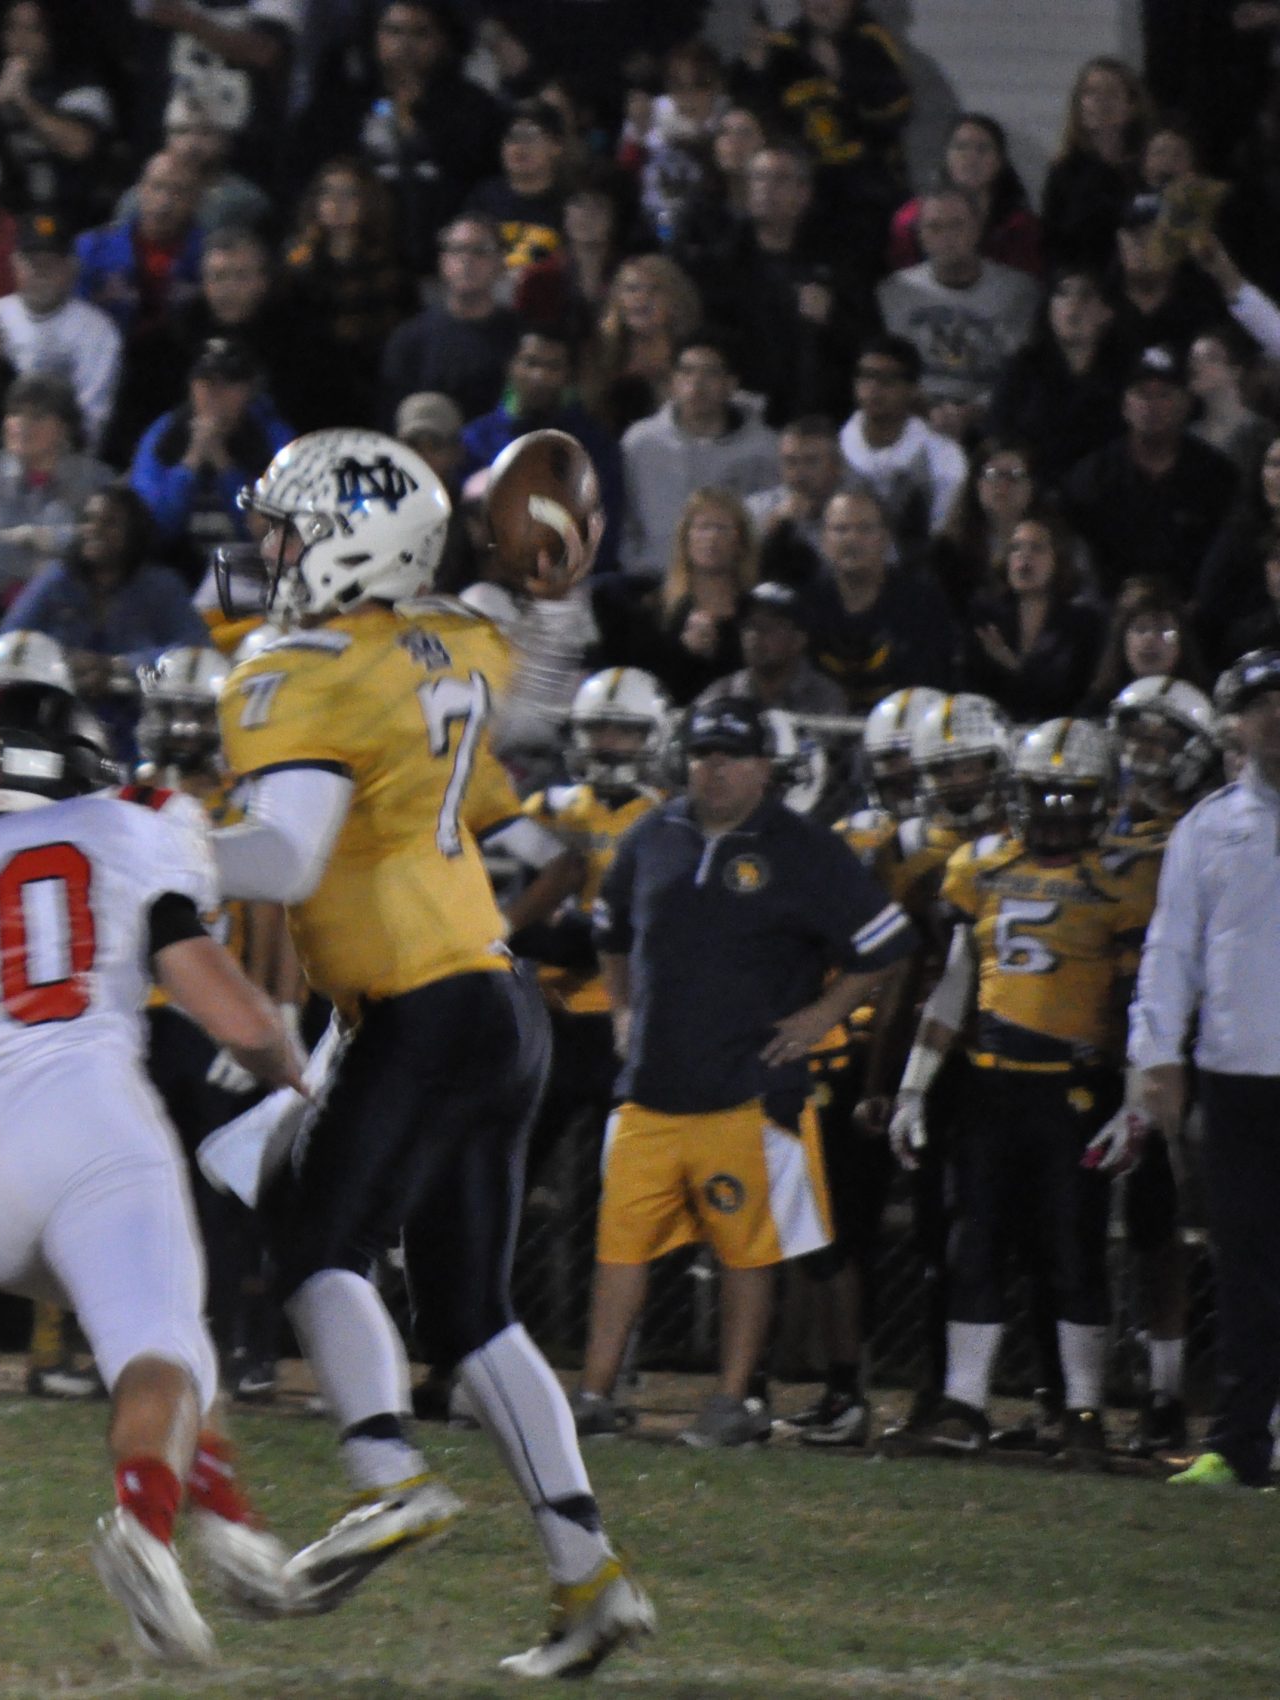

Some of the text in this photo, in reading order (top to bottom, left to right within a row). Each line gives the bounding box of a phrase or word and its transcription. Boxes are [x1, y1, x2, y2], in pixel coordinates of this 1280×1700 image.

[239, 670, 289, 731] 7
[417, 669, 480, 857] 7
[993, 897, 1062, 974] 5
